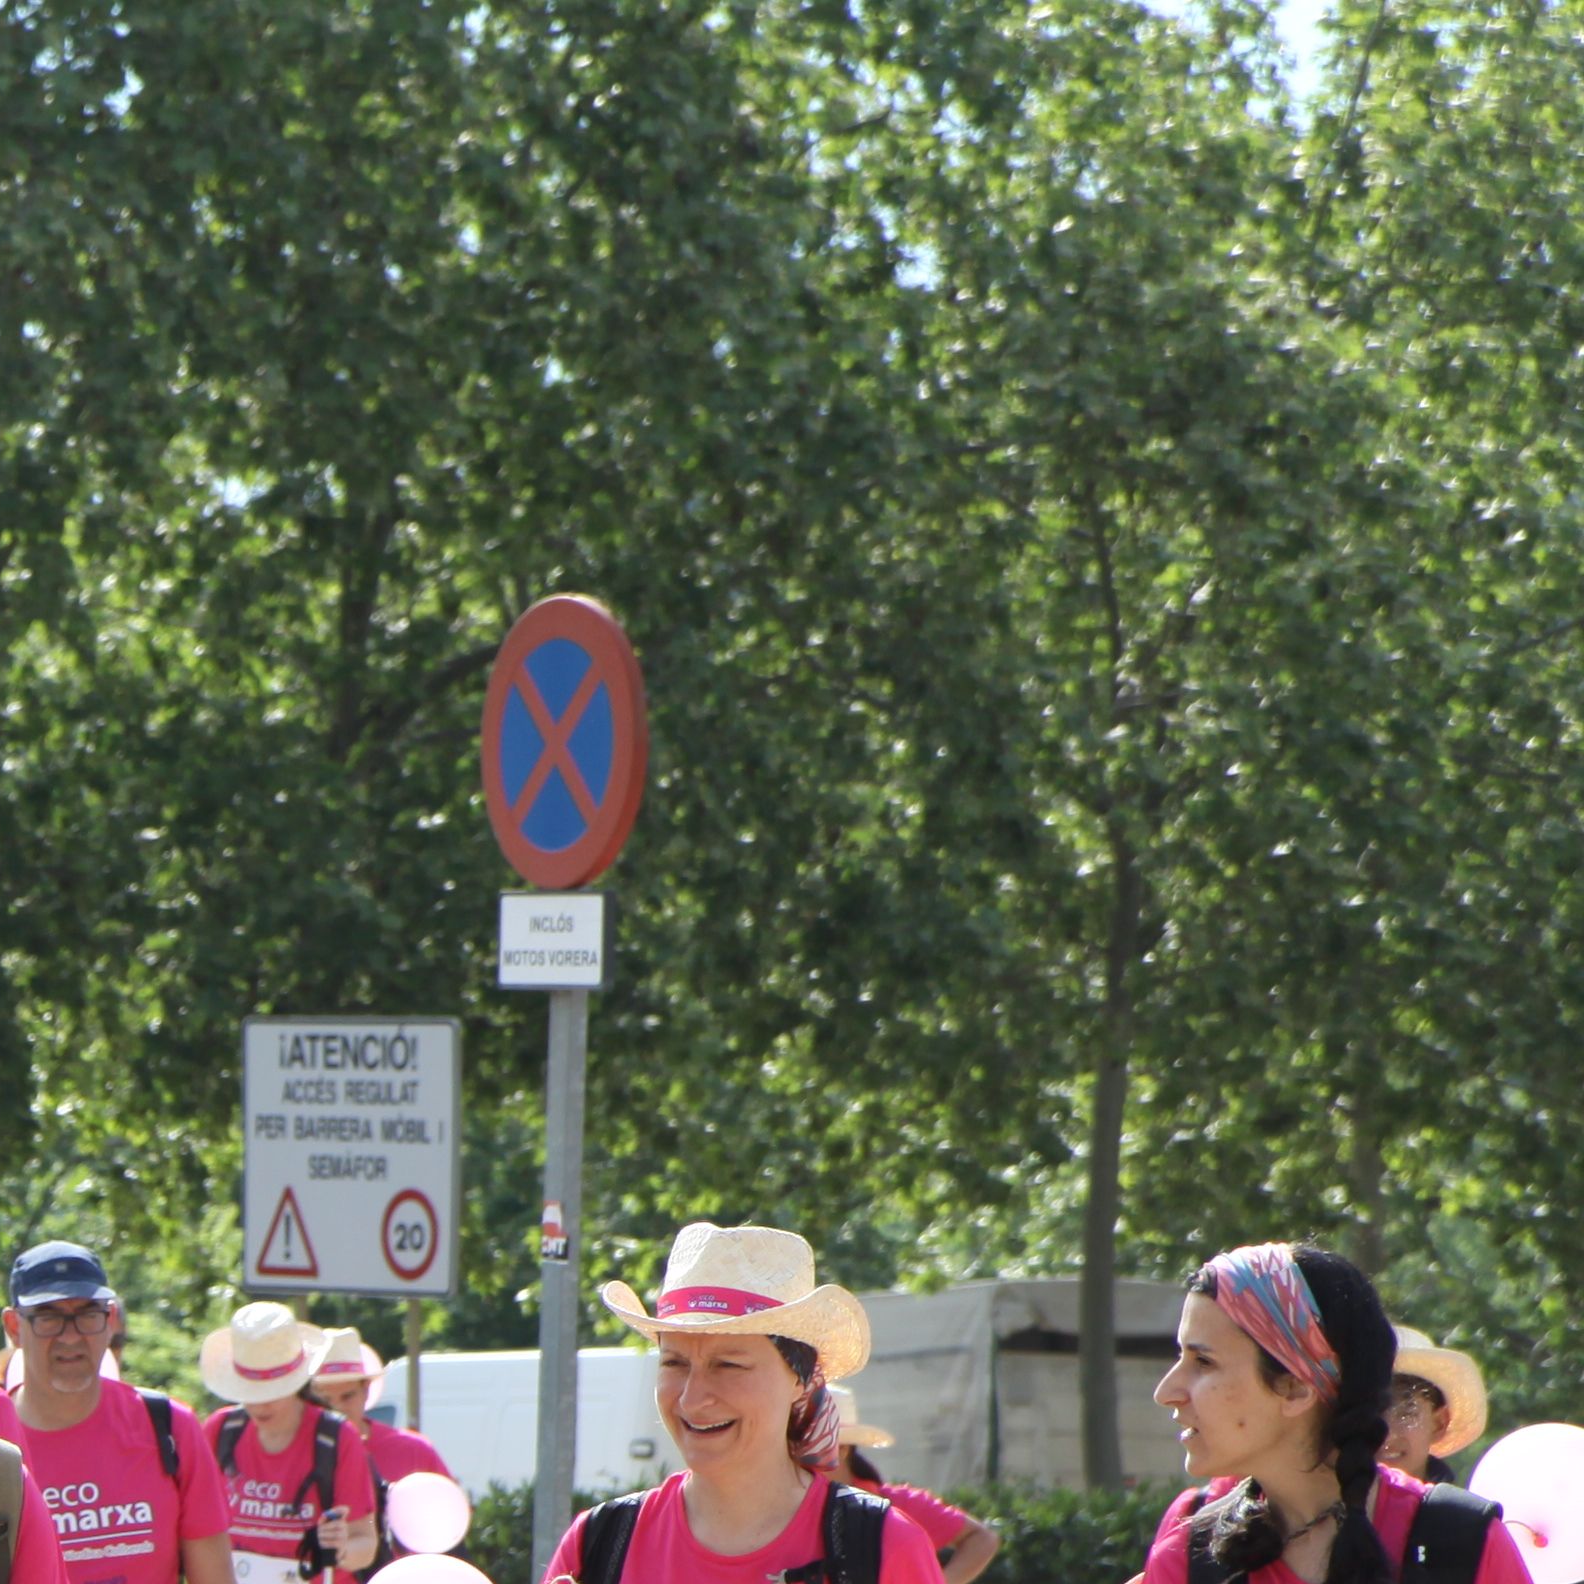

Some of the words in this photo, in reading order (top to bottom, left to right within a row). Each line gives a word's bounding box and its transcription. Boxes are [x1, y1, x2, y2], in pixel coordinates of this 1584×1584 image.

[529, 912, 574, 932] INCLÓS
[504, 950, 545, 967] MOTOS
[548, 950, 598, 967] VORERA
[280, 1027, 418, 1071] ¡ATENCIÓ!
[345, 1080, 419, 1105] REGULAT
[255, 1114, 286, 1139] PER
[294, 1116, 372, 1141] BARRERA
[394, 1224, 425, 1251] 20
[43, 1482, 99, 1508] eco
[244, 1480, 281, 1499] eco
